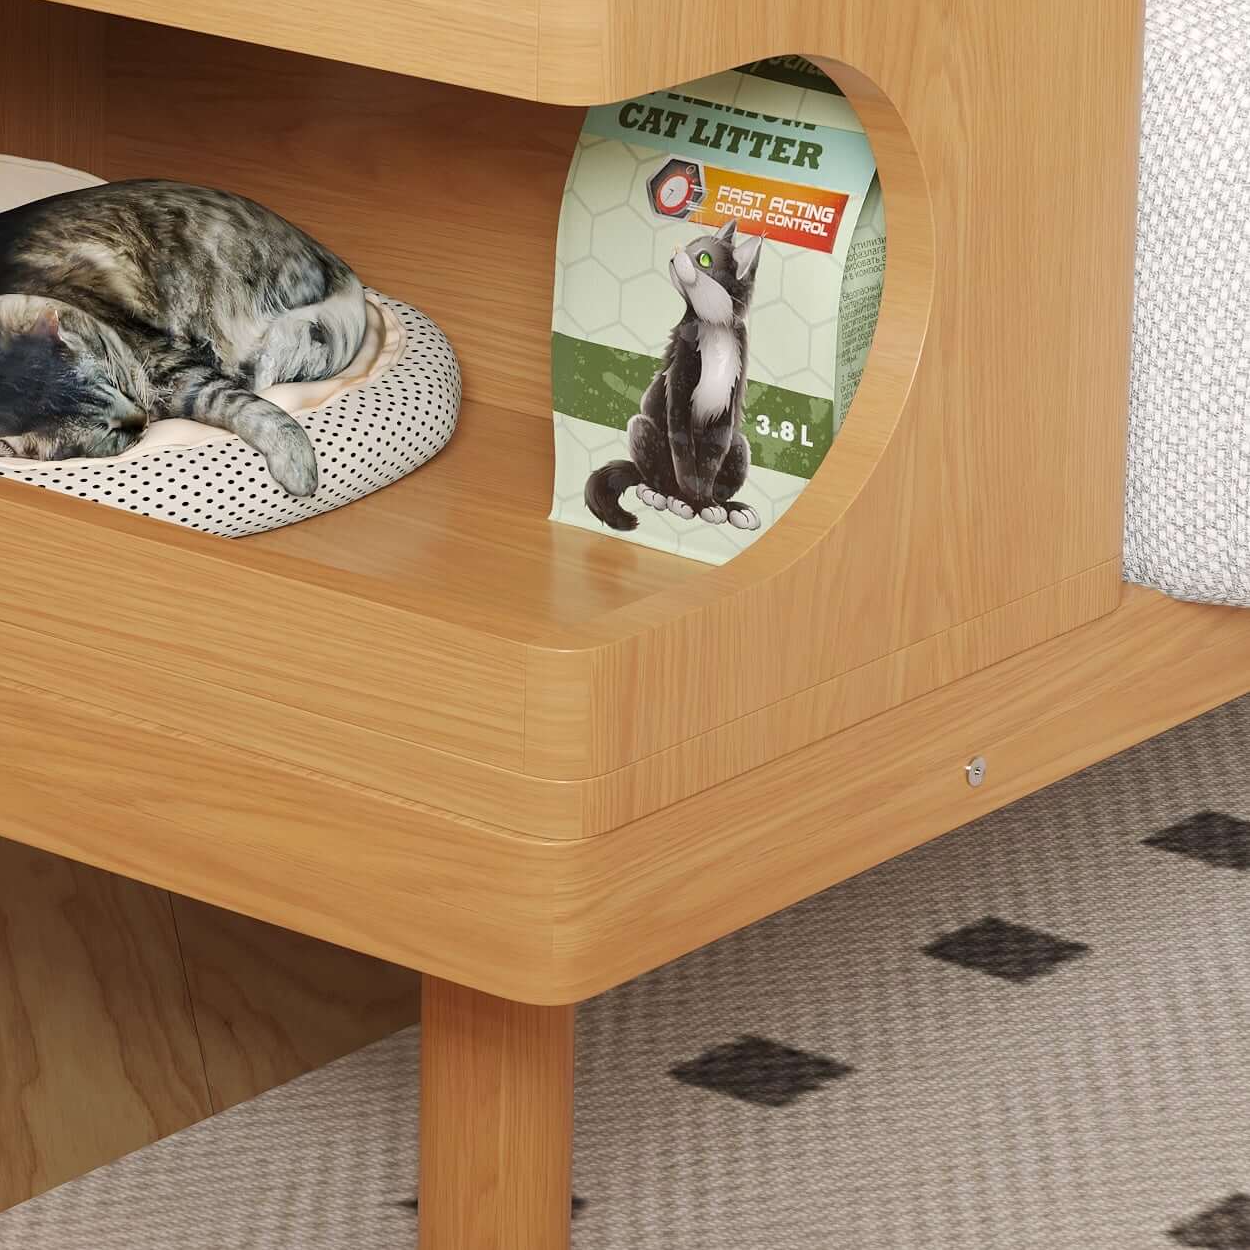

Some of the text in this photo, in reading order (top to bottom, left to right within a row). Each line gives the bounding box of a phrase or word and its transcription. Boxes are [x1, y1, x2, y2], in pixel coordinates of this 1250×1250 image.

[618, 102, 688, 139] CAT
[689, 117, 824, 170] LITTER
[715, 201, 828, 237] ODOUR CONTROL
[717, 185, 835, 224] FAST ACTING
[755, 414, 814, 448] 3.8 L
